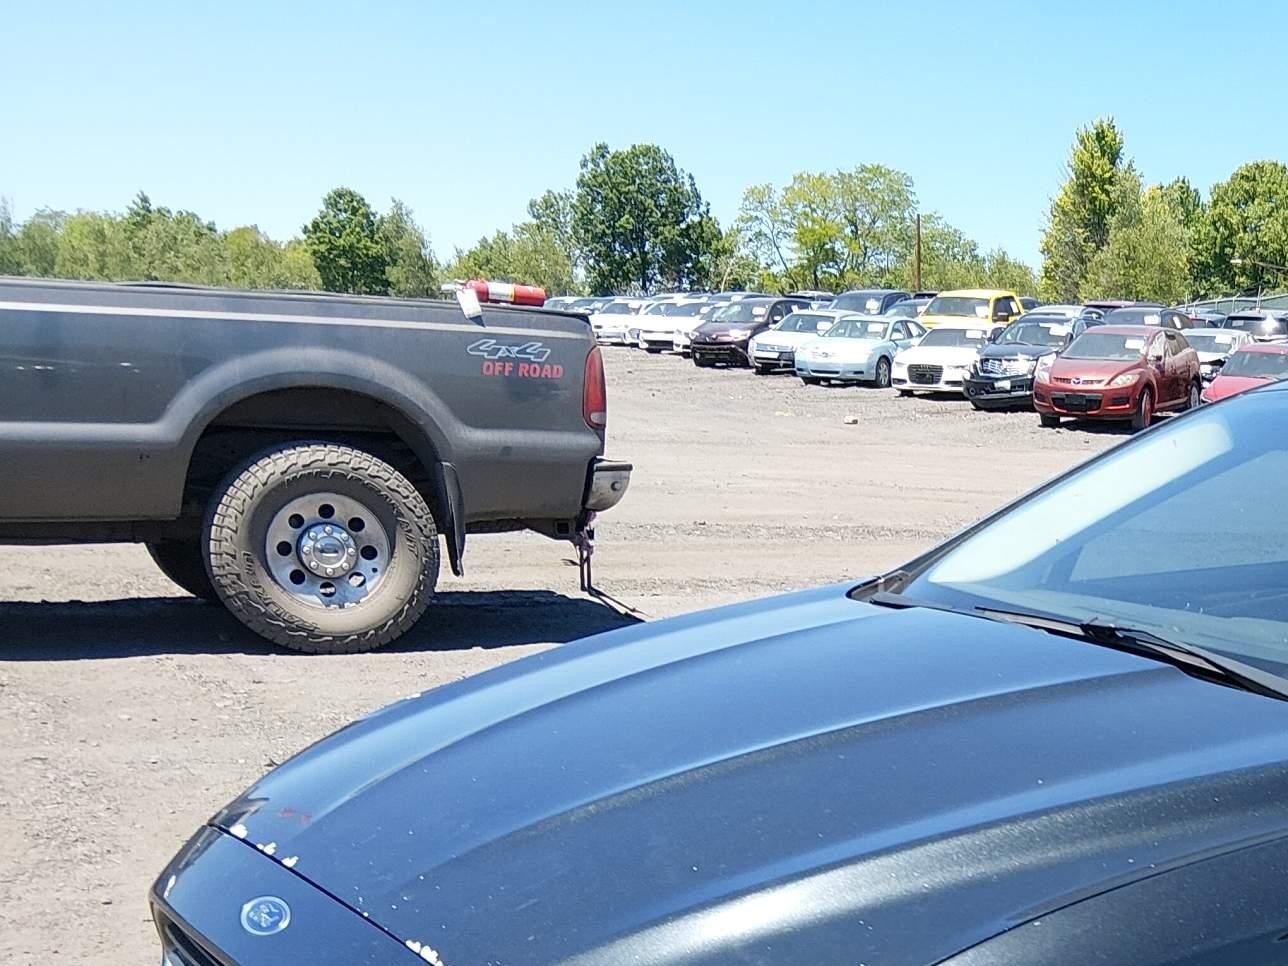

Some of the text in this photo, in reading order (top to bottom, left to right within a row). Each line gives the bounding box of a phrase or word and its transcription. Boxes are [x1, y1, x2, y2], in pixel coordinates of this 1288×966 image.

[466, 338, 551, 362] 4x4
[482, 361, 564, 379] OFF ROAD
